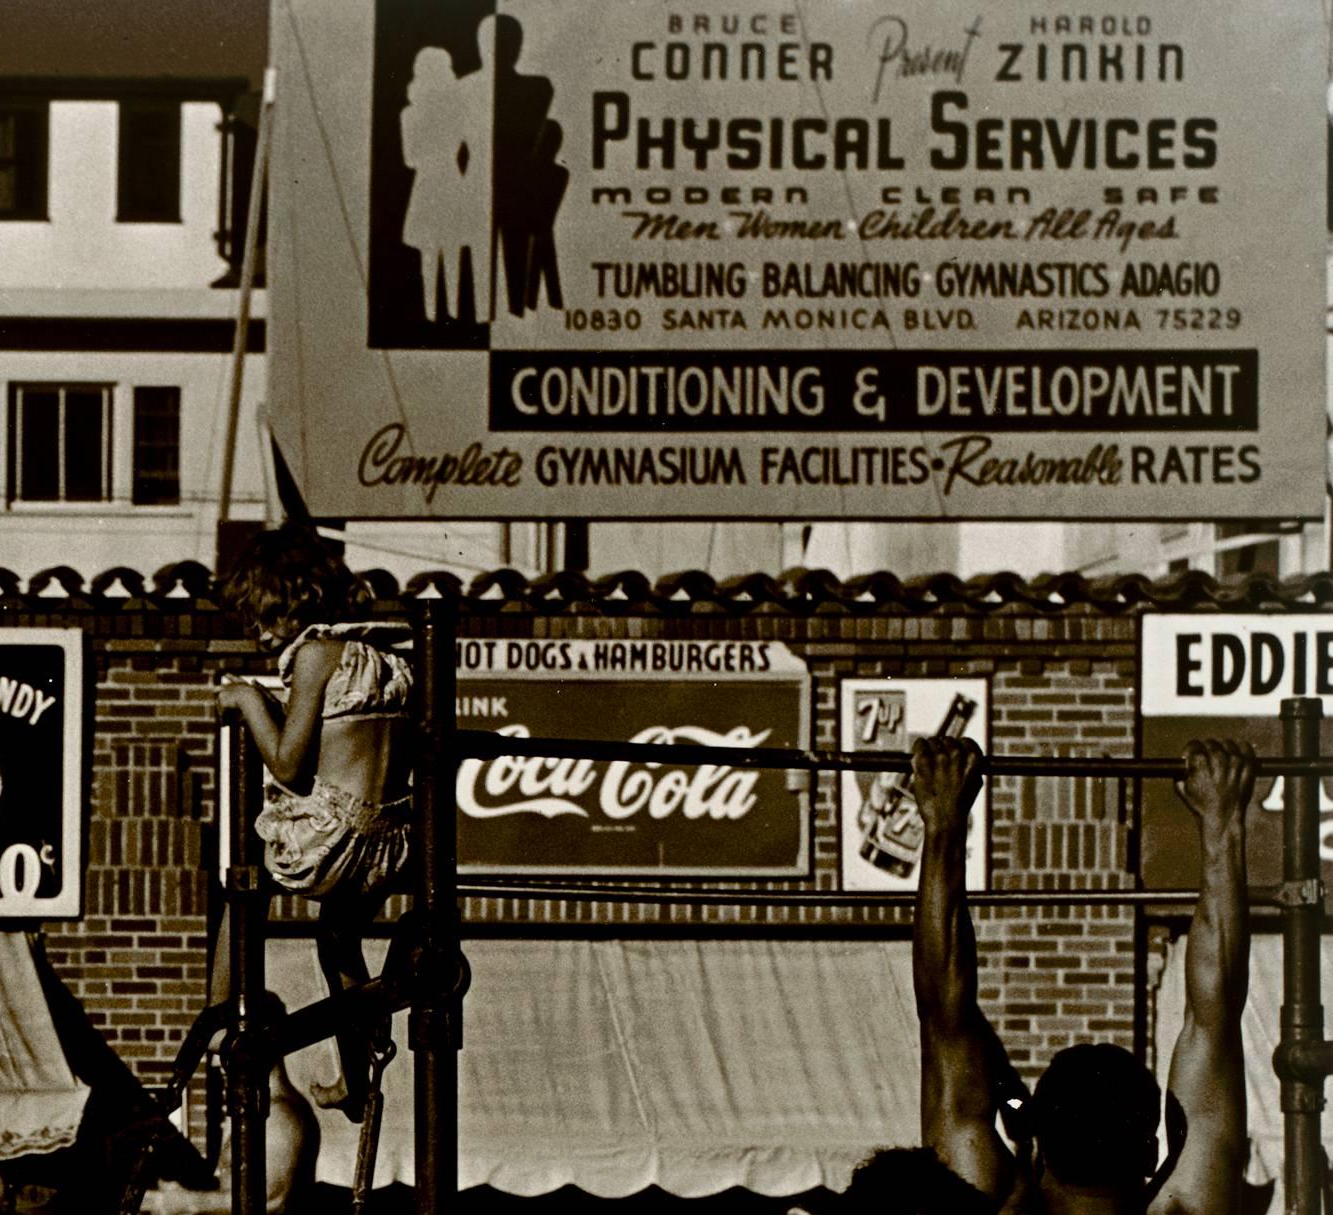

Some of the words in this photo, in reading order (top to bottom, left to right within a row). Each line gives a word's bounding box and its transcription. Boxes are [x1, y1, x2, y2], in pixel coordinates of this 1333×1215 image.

[668, 14, 799, 35] BRUCE
[1030, 15, 1153, 37] HAROLD
[631, 41, 834, 82] CONNER
[867, 14, 983, 105] Present
[994, 42, 1184, 82] ZINKIN
[591, 90, 905, 171] PHYSICAL
[929, 90, 1218, 171] SERVICES
[591, 186, 808, 205] MODERN
[881, 186, 1031, 205] CLEAN
[1103, 186, 1220, 205] SAFE
[620, 210, 721, 241] Men
[728, 209, 845, 241] Women
[857, 207, 1019, 242] Children
[1023, 206, 1094, 242] All
[1091, 206, 1180, 254] Ages
[590, 262, 747, 298] TUMBLING
[761, 262, 921, 299] BALANCING
[935, 261, 1110, 299] GYMNASTICS
[1120, 261, 1222, 299] ADAGIO
[564, 308, 642, 332] 10830
[662, 308, 748, 331] SANTA
[761, 308, 891, 331] MONICA
[1015, 308, 1142, 331] ARIZONA
[1155, 307, 1242, 331] 75229
[510, 366, 825, 416] CONDITIONING
[852, 366, 886, 422] &
[916, 364, 1241, 416] DEVELOPMENT
[357, 422, 524, 504] Complete
[534, 446, 748, 487] GYMNASIUM
[939, 434, 1123, 496] Reasonable
[1132, 445, 1262, 484] RATES
[456, 641, 498, 670] OT
[507, 641, 573, 671] DOGS
[593, 642, 772, 672] HAMBURGERS
[1175, 631, 1333, 697] EDDIE
[456, 696, 510, 718] INK
